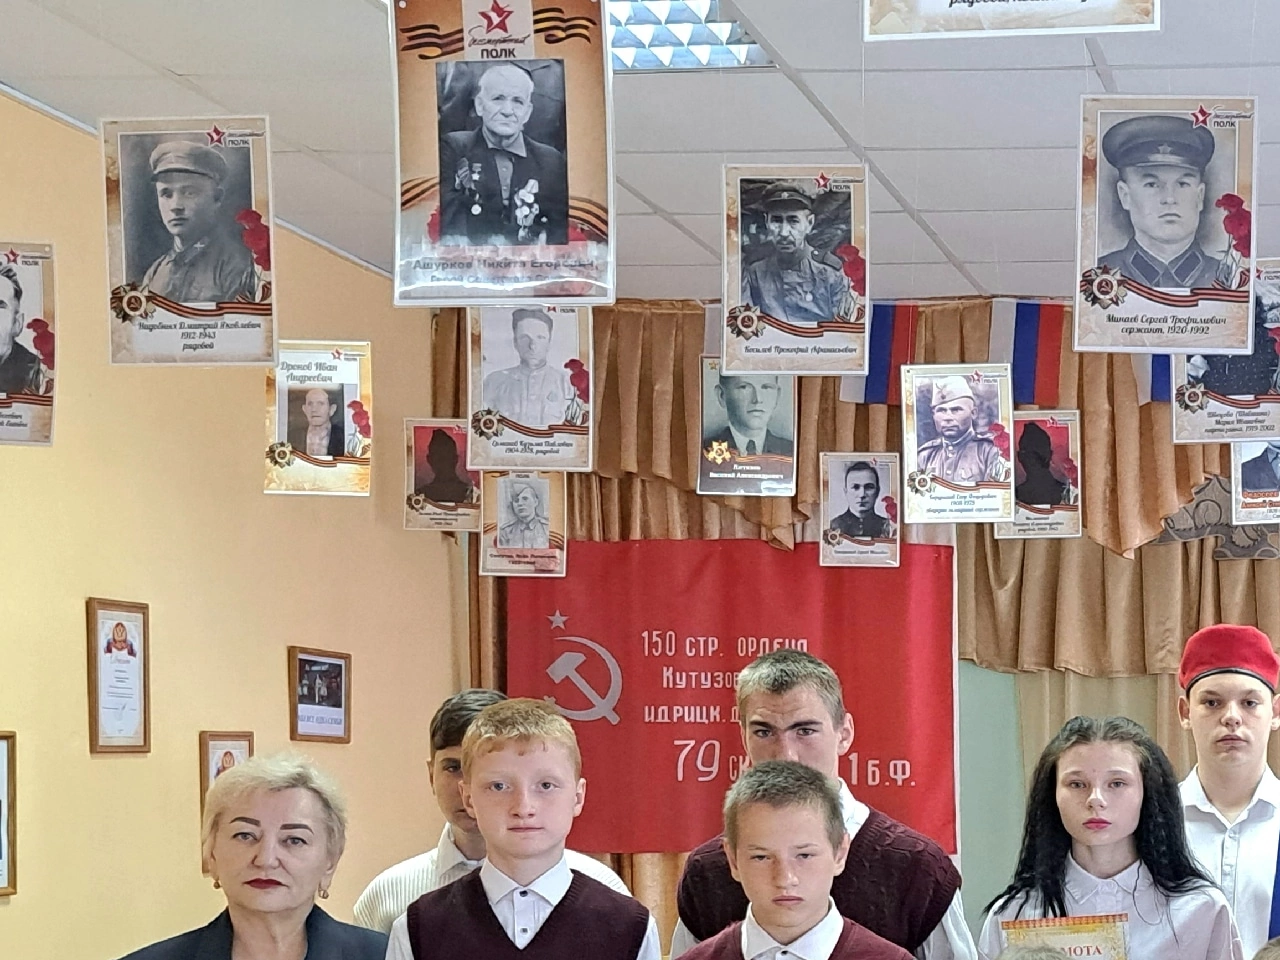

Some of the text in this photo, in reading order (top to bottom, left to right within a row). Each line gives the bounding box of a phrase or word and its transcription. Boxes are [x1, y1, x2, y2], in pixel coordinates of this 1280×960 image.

[481, 48, 516, 58] ПОЛК
[1106, 314, 1226, 327] Минаев Сергей Трофимович
[1167, 326, 1210, 334] 1920-1992
[642, 630, 676, 656] 150
[685, 636, 724, 657] СТР.
[644, 706, 726, 724] ИДРИЦК.
[673, 740, 720, 782] 79
